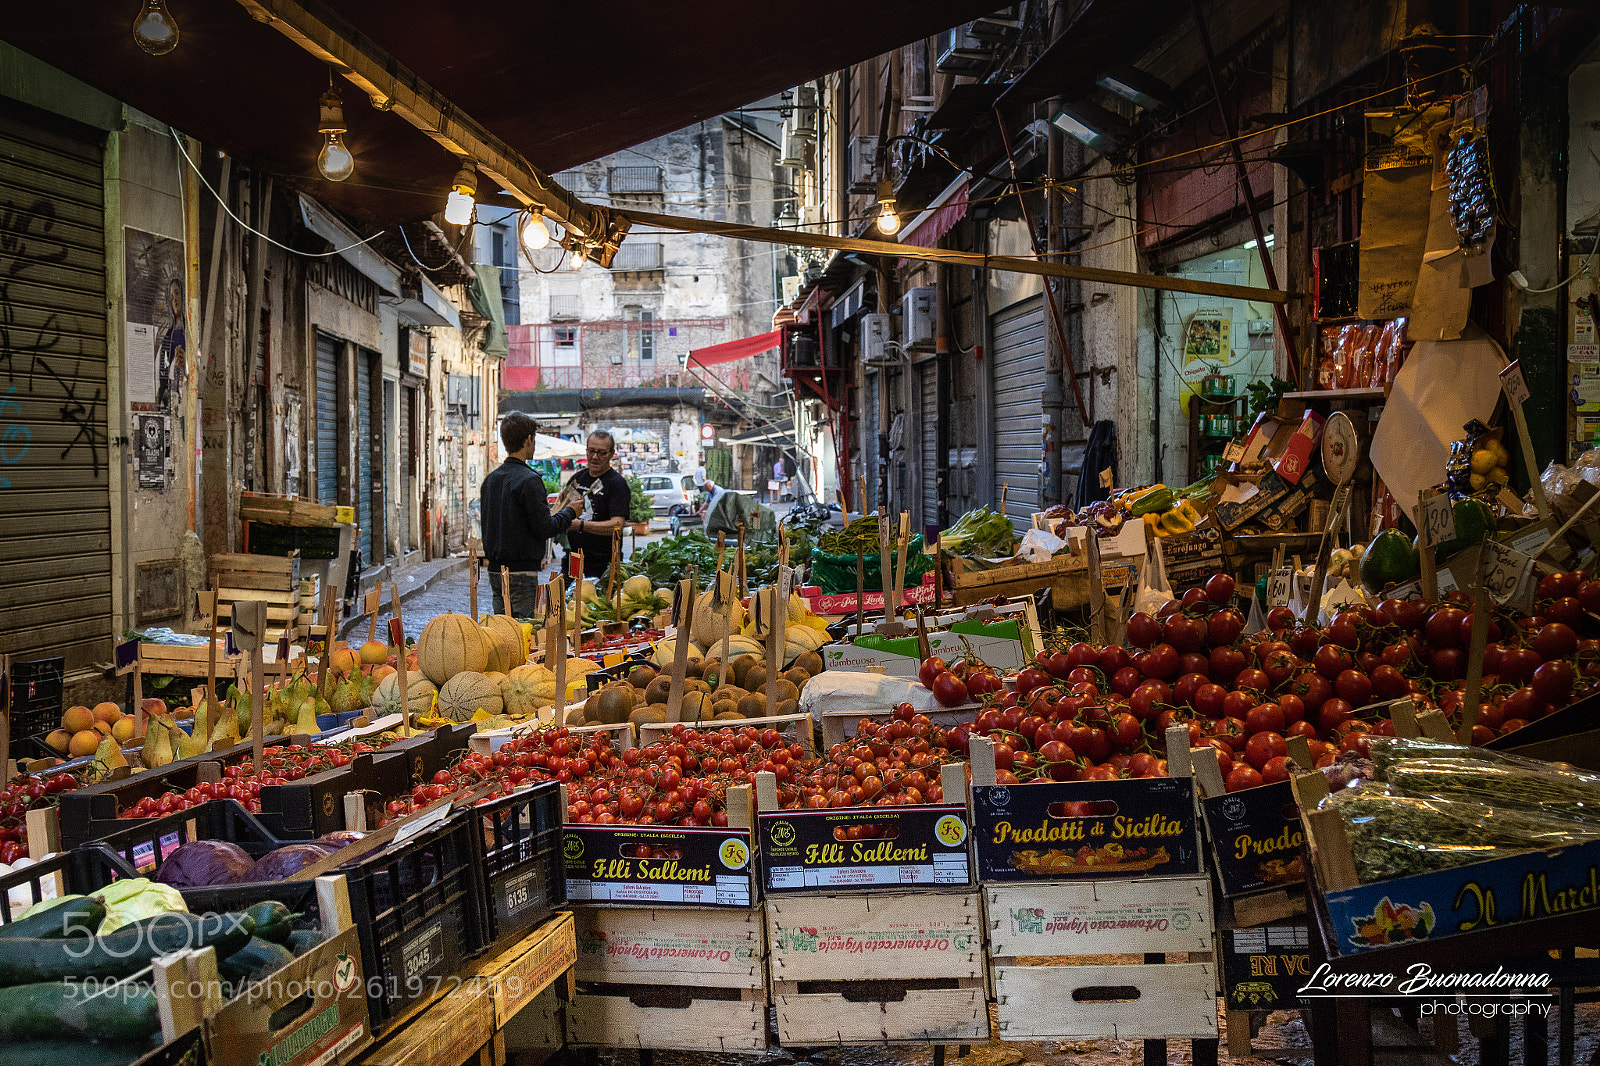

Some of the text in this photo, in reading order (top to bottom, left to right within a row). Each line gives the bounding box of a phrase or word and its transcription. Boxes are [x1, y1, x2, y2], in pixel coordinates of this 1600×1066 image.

[834, 596, 857, 608] Pin
[829, 657, 876, 668] dambruoso
[993, 813, 1184, 844] Prodotti di Sicilia
[804, 842, 845, 865] F.lli
[851, 841, 928, 863] Sallemi
[592, 858, 632, 879] F.lli
[637, 859, 712, 882] Sallemi
[508, 886, 528, 909] 6135
[407, 947, 430, 976] 3045
[1249, 955, 1278, 977] RE
